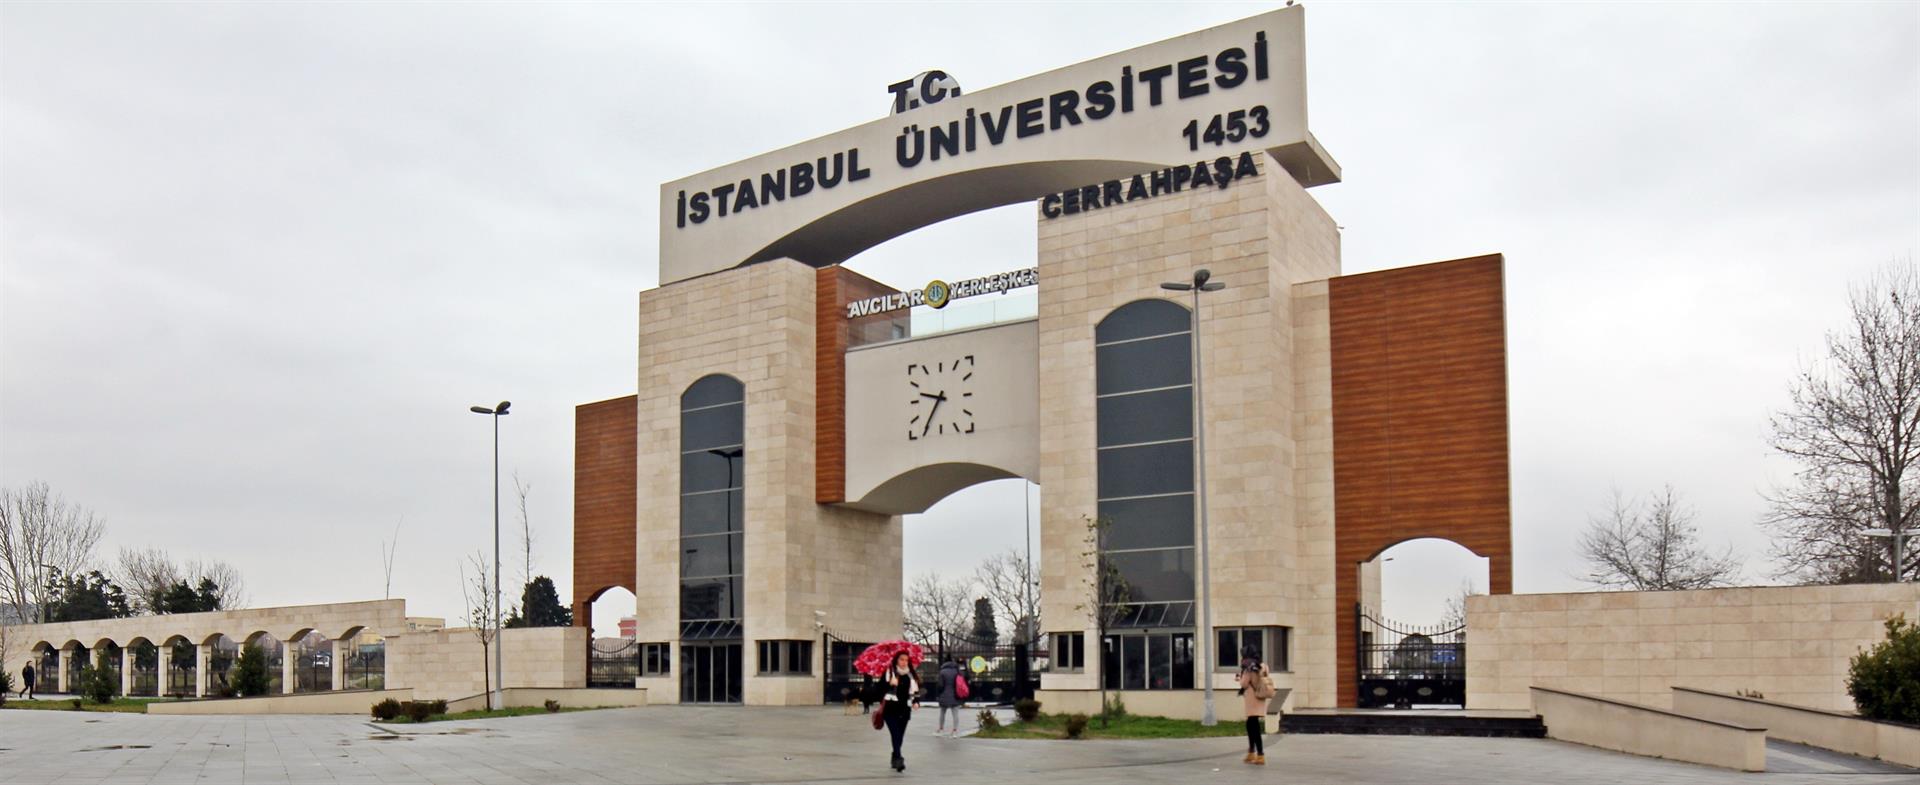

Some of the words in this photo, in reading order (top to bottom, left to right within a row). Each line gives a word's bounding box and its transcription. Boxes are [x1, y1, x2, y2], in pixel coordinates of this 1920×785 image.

[888, 70, 961, 114] T.C.
[677, 147, 871, 229] İSTANBUL
[896, 30, 1270, 168] ÜNİVERSİTESİ
[1182, 105, 1270, 152] 1453
[1042, 151, 1259, 219] CERRAHPAŞA
[847, 289, 924, 319] AVCILAR
